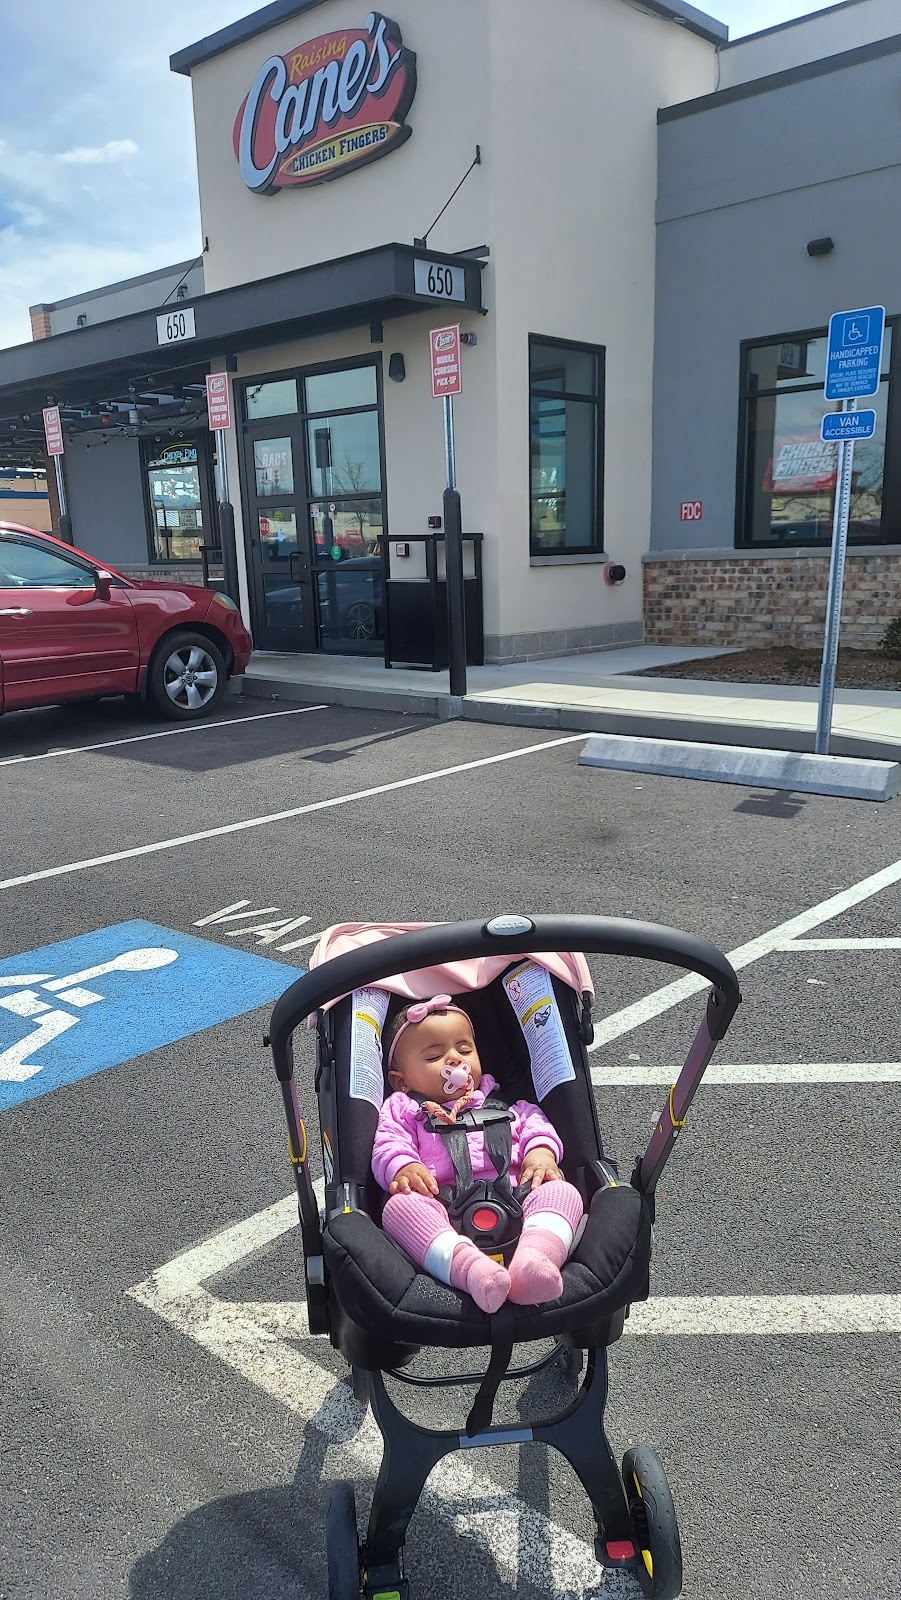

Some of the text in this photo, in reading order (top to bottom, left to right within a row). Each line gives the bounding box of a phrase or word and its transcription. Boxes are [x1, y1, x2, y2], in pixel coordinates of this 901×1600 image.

[289, 36, 347, 82] Raising
[239, 13, 401, 188] Cane's
[292, 126, 388, 173] CHICKEN FINGERS
[428, 265, 452, 296] 650
[167, 313, 185, 340] 650
[436, 353, 455, 364] MOBILE
[830, 345, 879, 360] HANDICAPPED
[434, 364, 458, 376] CURBSIDE
[838, 357, 868, 369] PARKING
[437, 376, 456, 387] PICK-UP
[839, 416, 859, 427] VAN
[825, 426, 872, 436] ACCESSIBLE
[777, 442, 838, 461] CHICKE
[681, 502, 701, 520] FDC
